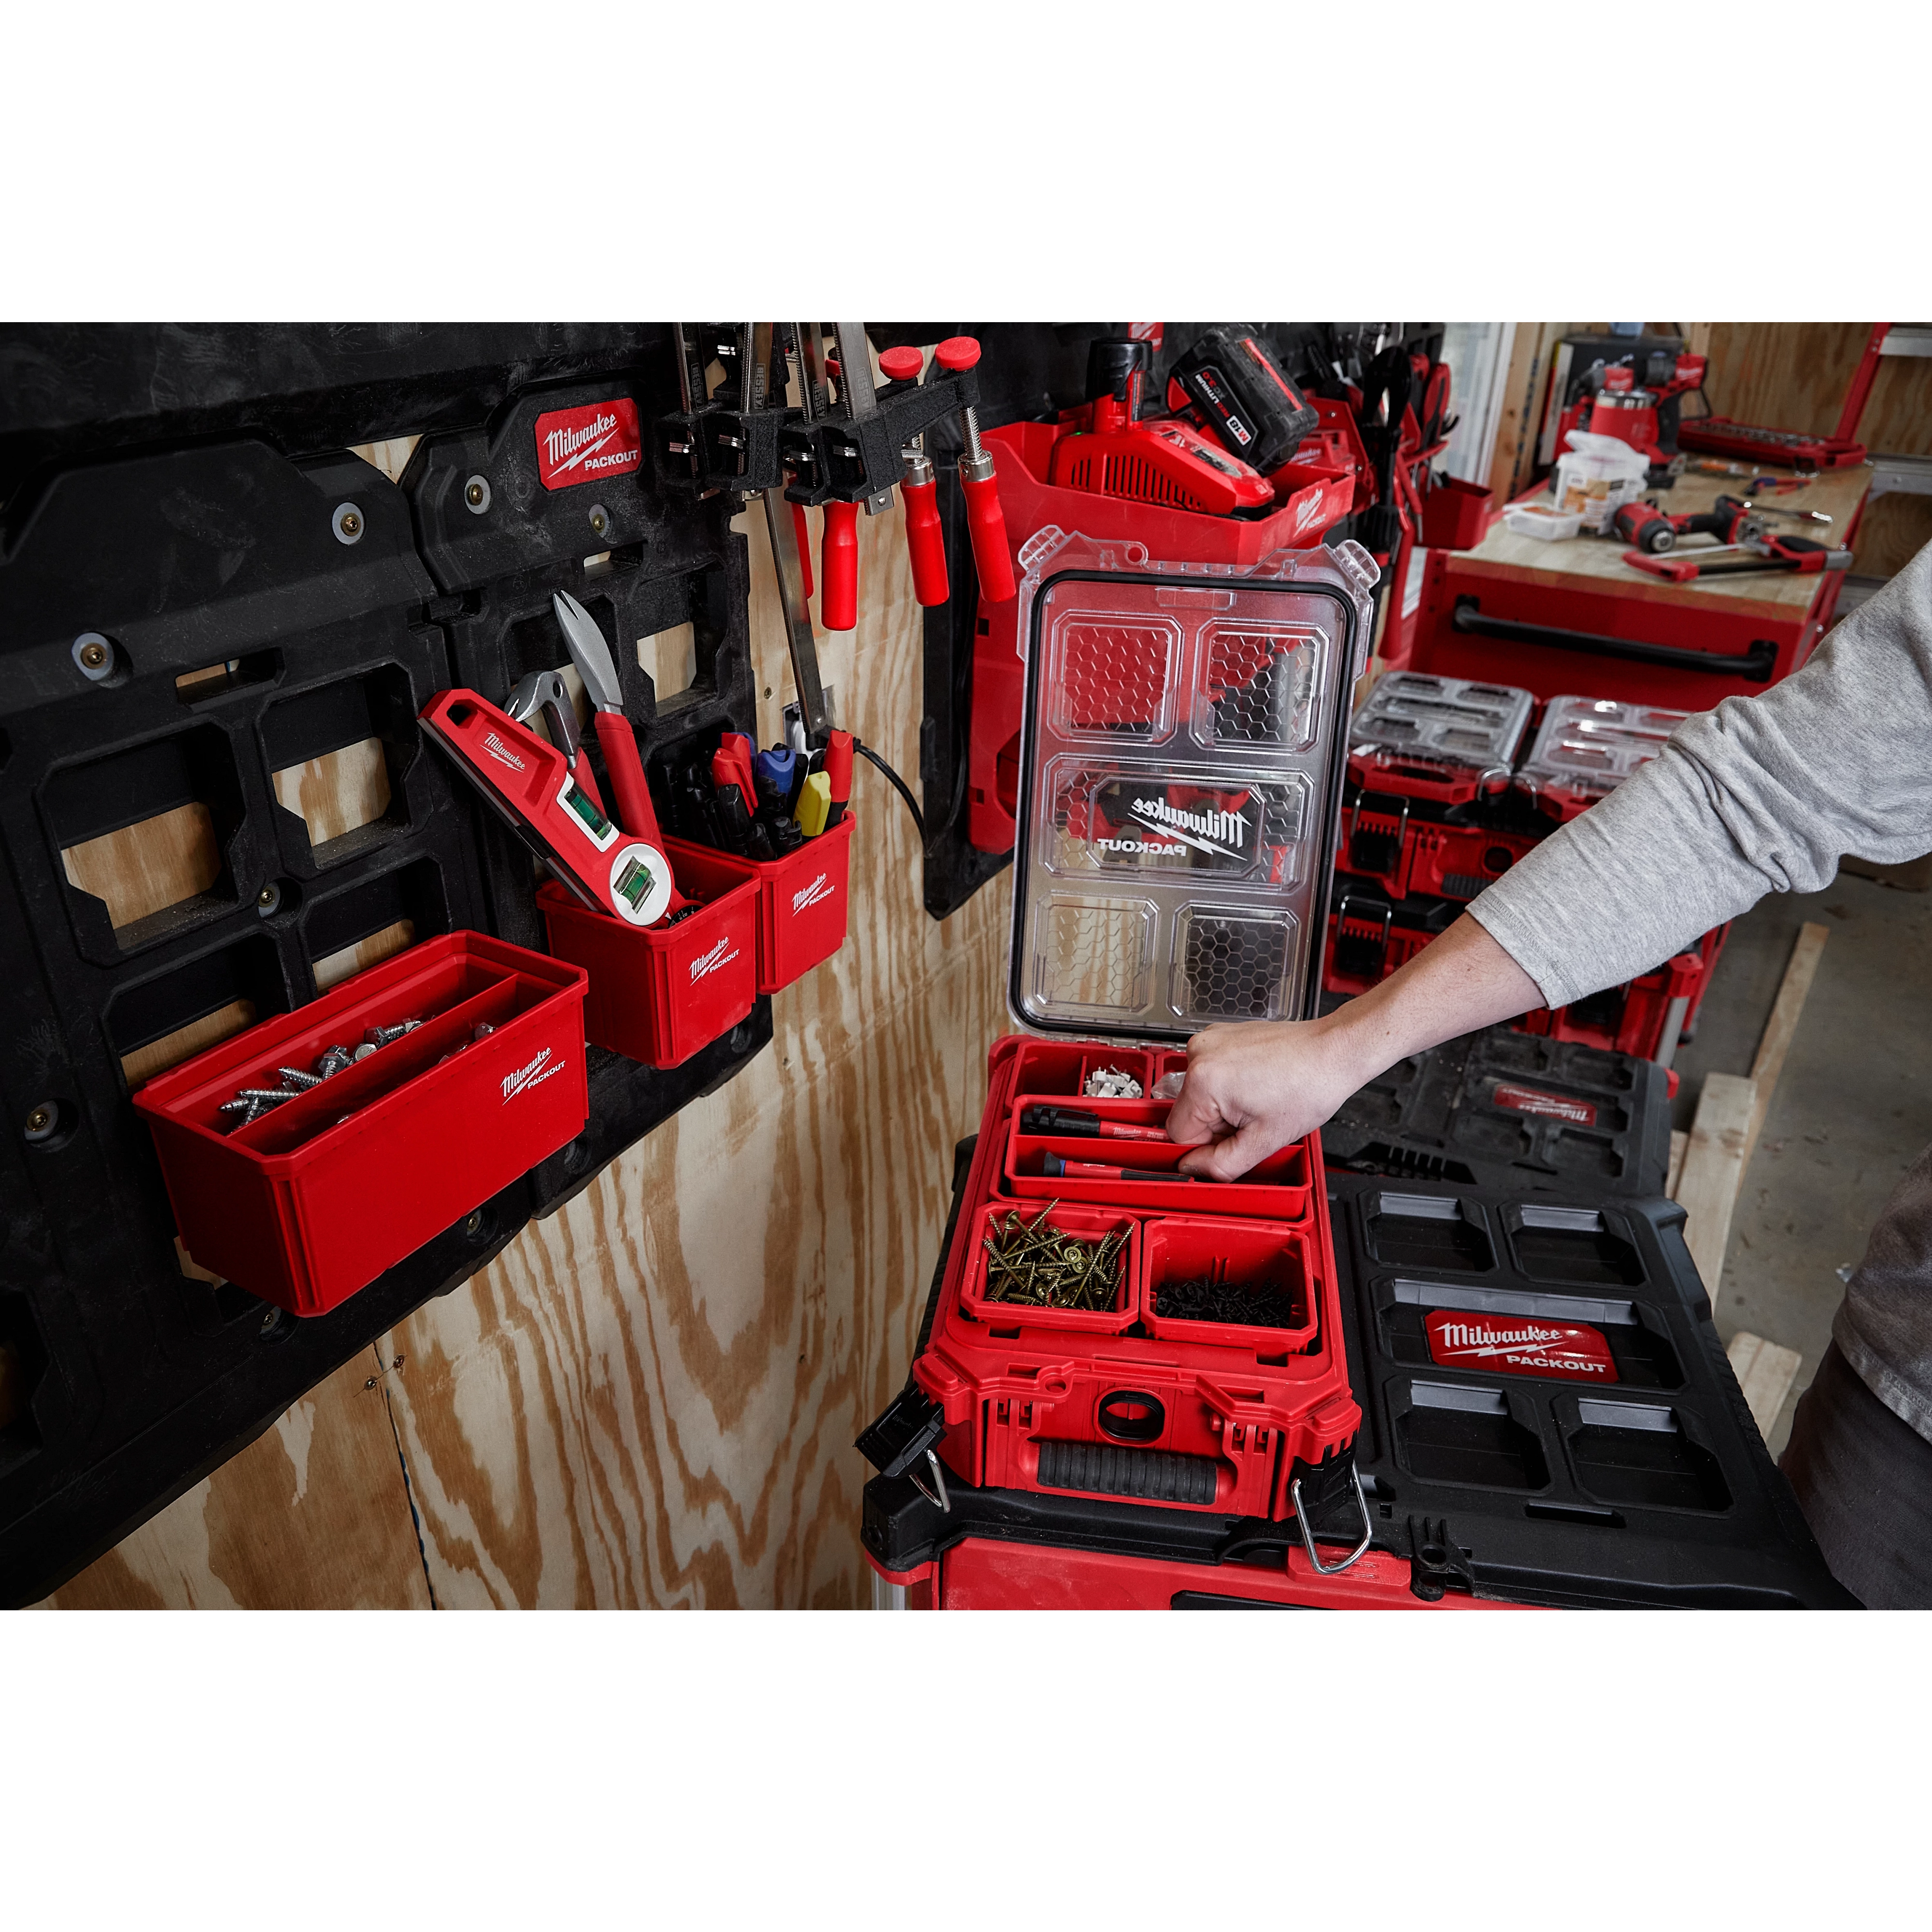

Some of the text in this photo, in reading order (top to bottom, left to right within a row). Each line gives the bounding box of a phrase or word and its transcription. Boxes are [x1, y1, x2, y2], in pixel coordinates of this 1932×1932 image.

[692, 366, 702, 404] BESSEY
[754, 367, 765, 406] BESSEY
[542, 413, 617, 466] Milwaukee
[1229, 419, 1249, 442] M18
[584, 450, 638, 471] PACKOUT
[484, 732, 525, 769] Milwaukee
[792, 873, 826, 910] Milwaukee
[809, 885, 835, 907] PACKOUT
[688, 937, 729, 979] Milwaukee
[710, 949, 740, 973] PACKOUT
[499, 1047, 552, 1097] Milwaukee
[527, 1060, 566, 1089] PACKOUT
[1113, 1127, 1141, 1136] Milwaukee
[1434, 1322, 1563, 1348] Milwaukee
[1506, 1355, 1606, 1373] PACKOUT
